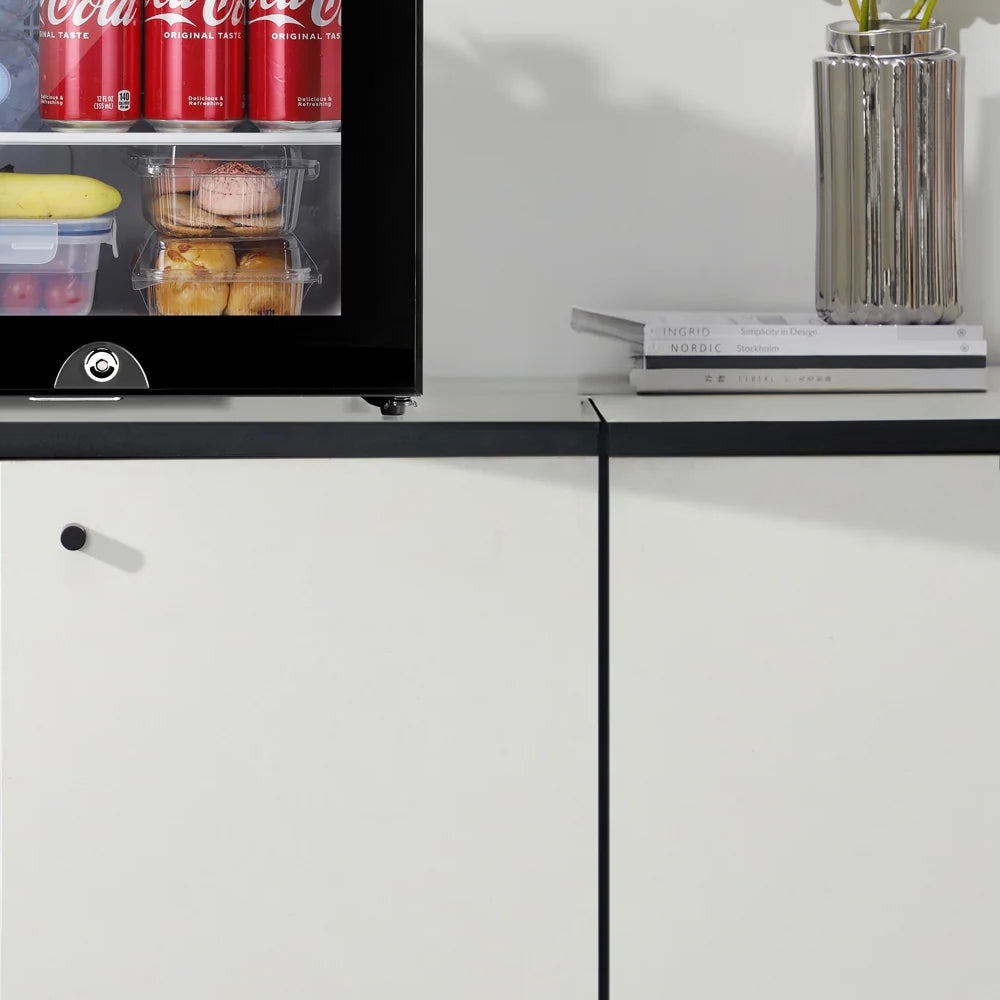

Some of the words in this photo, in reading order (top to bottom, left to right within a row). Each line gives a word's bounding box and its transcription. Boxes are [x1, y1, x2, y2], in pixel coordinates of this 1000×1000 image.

[58, 31, 89, 39] TASTE
[163, 31, 214, 40] ORIGINAL
[217, 32, 242, 40] TASTE
[271, 31, 323, 40] ORIGINAL
[663, 327, 710, 337] INGRID
[671, 343, 721, 353] NORDIC
